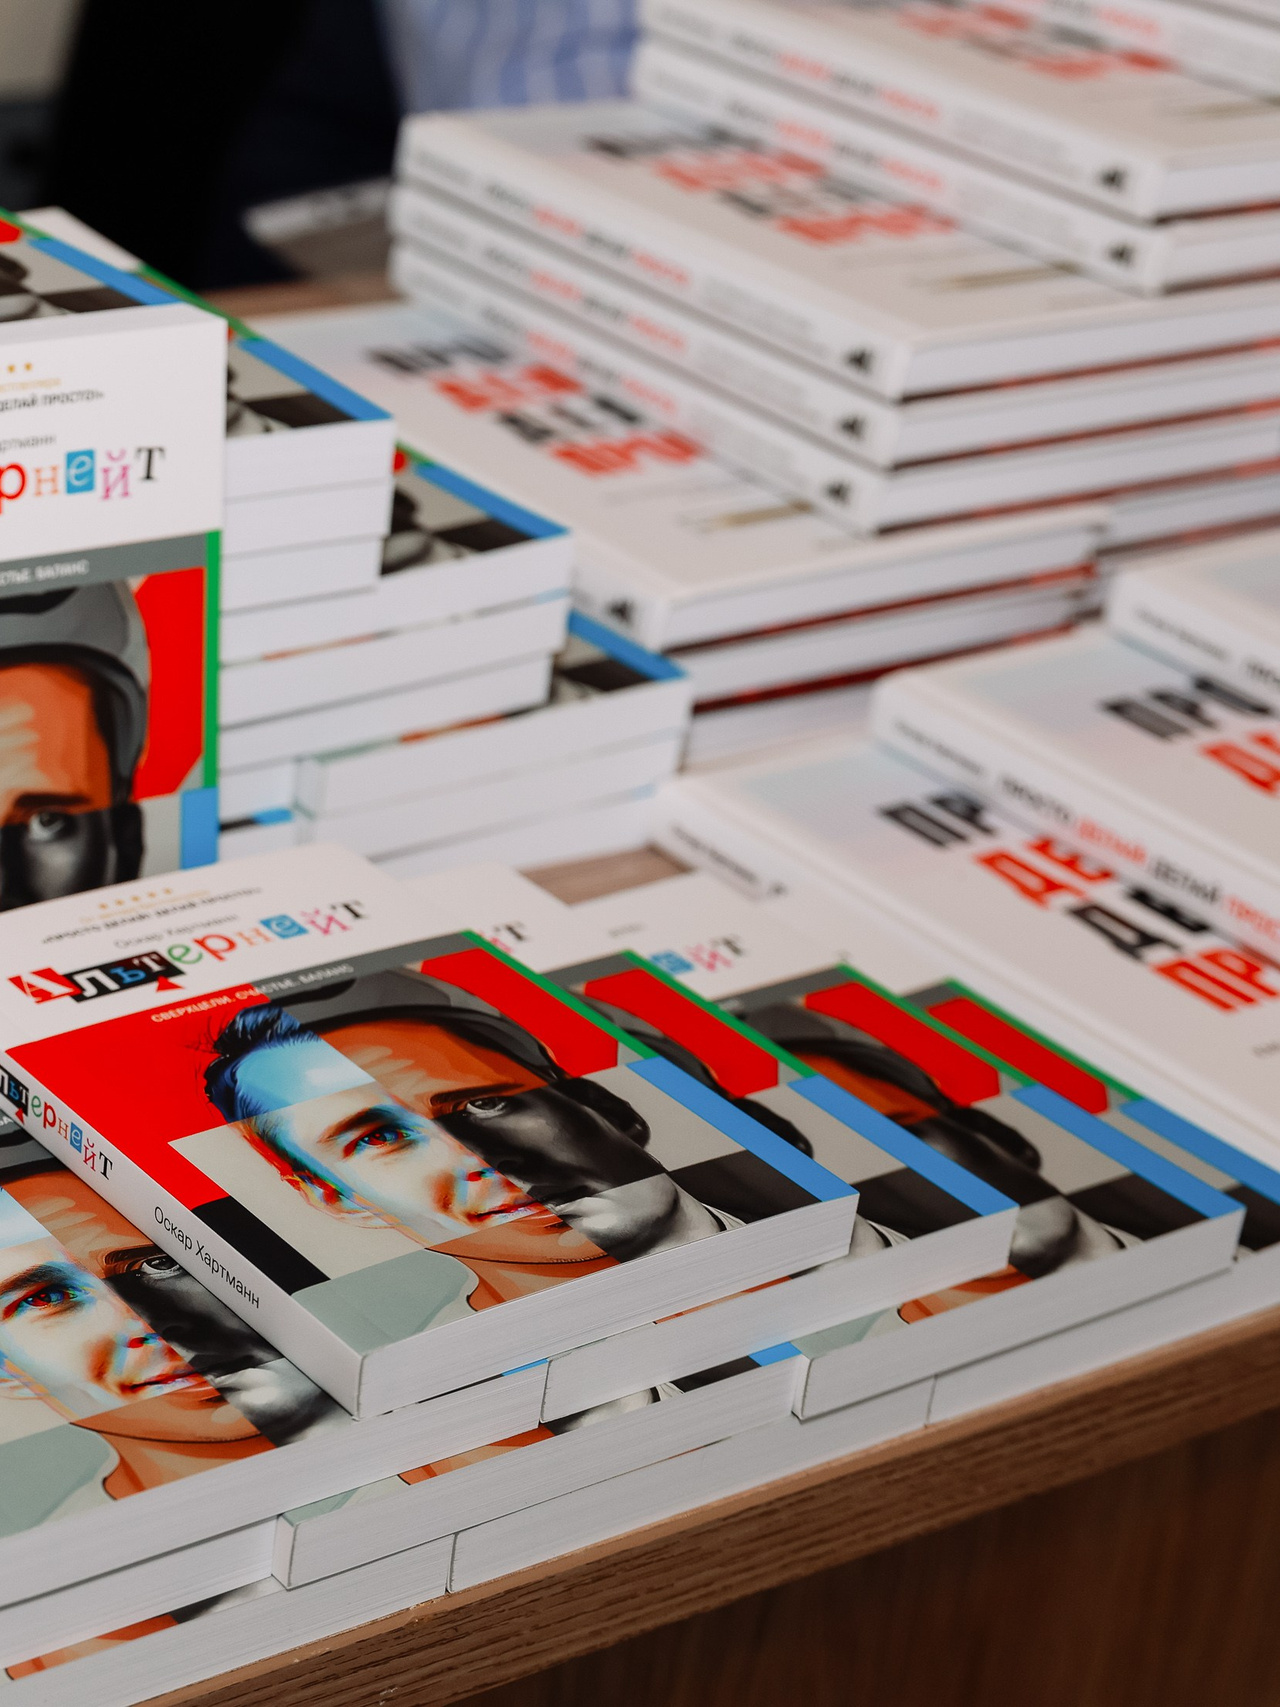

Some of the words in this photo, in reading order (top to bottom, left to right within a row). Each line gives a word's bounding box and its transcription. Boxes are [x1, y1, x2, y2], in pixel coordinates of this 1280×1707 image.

[35, 559, 90, 581] БАЛАНС
[151, 994, 236, 1023] СВЕРХЦЕЛИ.
[154, 1206, 193, 1251] Оскар
[195, 1240, 260, 1309] Хартманн
